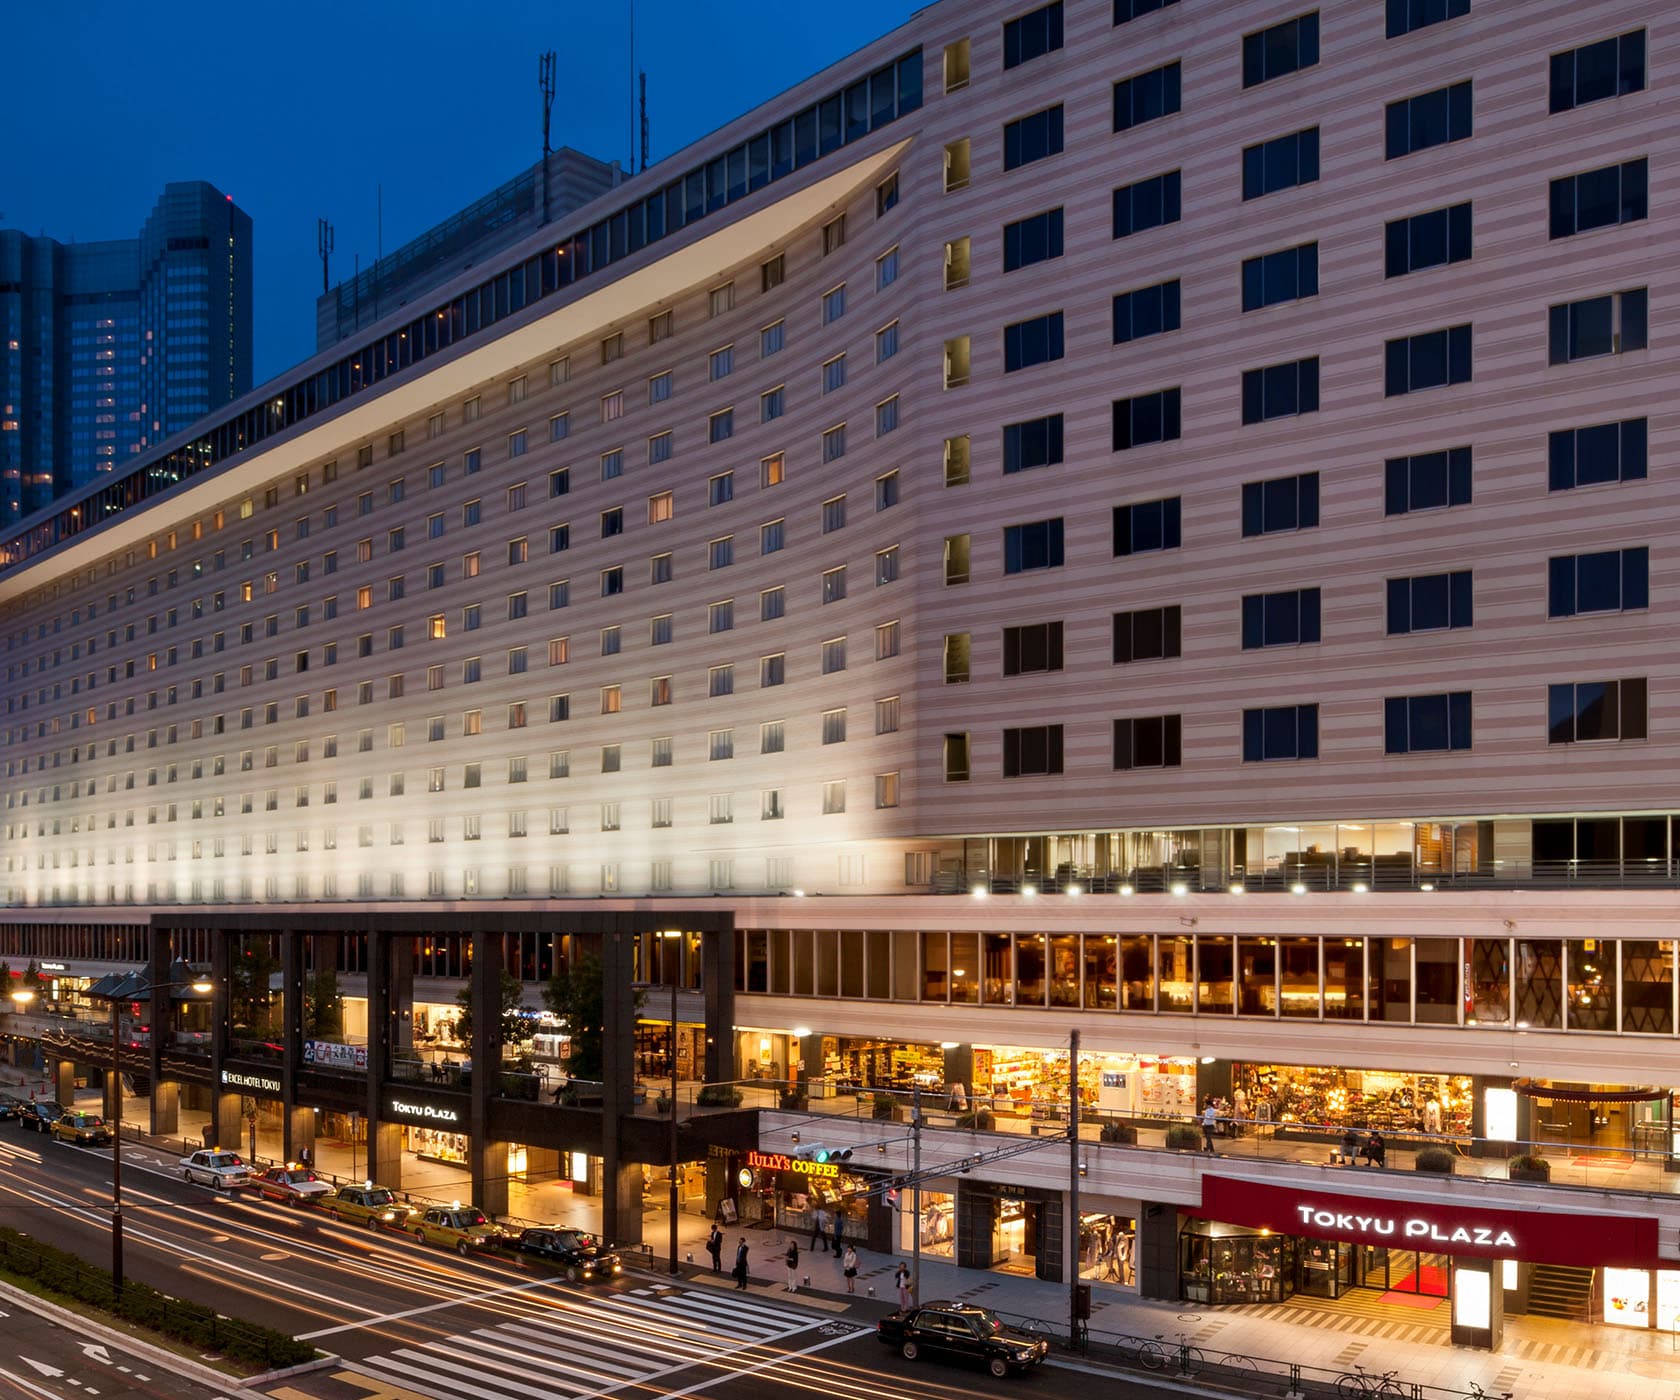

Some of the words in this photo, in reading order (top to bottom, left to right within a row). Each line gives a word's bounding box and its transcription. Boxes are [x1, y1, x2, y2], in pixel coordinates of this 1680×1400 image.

[228, 1073, 243, 1085] EXCEL
[243, 1076, 261, 1088] HOTEL
[261, 1079, 281, 1091] TOKYU
[392, 1101, 423, 1115] TOKYU
[424, 1106, 457, 1120] PLAZA
[791, 1160, 839, 1178] COFFEE
[1297, 1206, 1394, 1235] TOKYU
[1405, 1219, 1517, 1247] PLAZA
